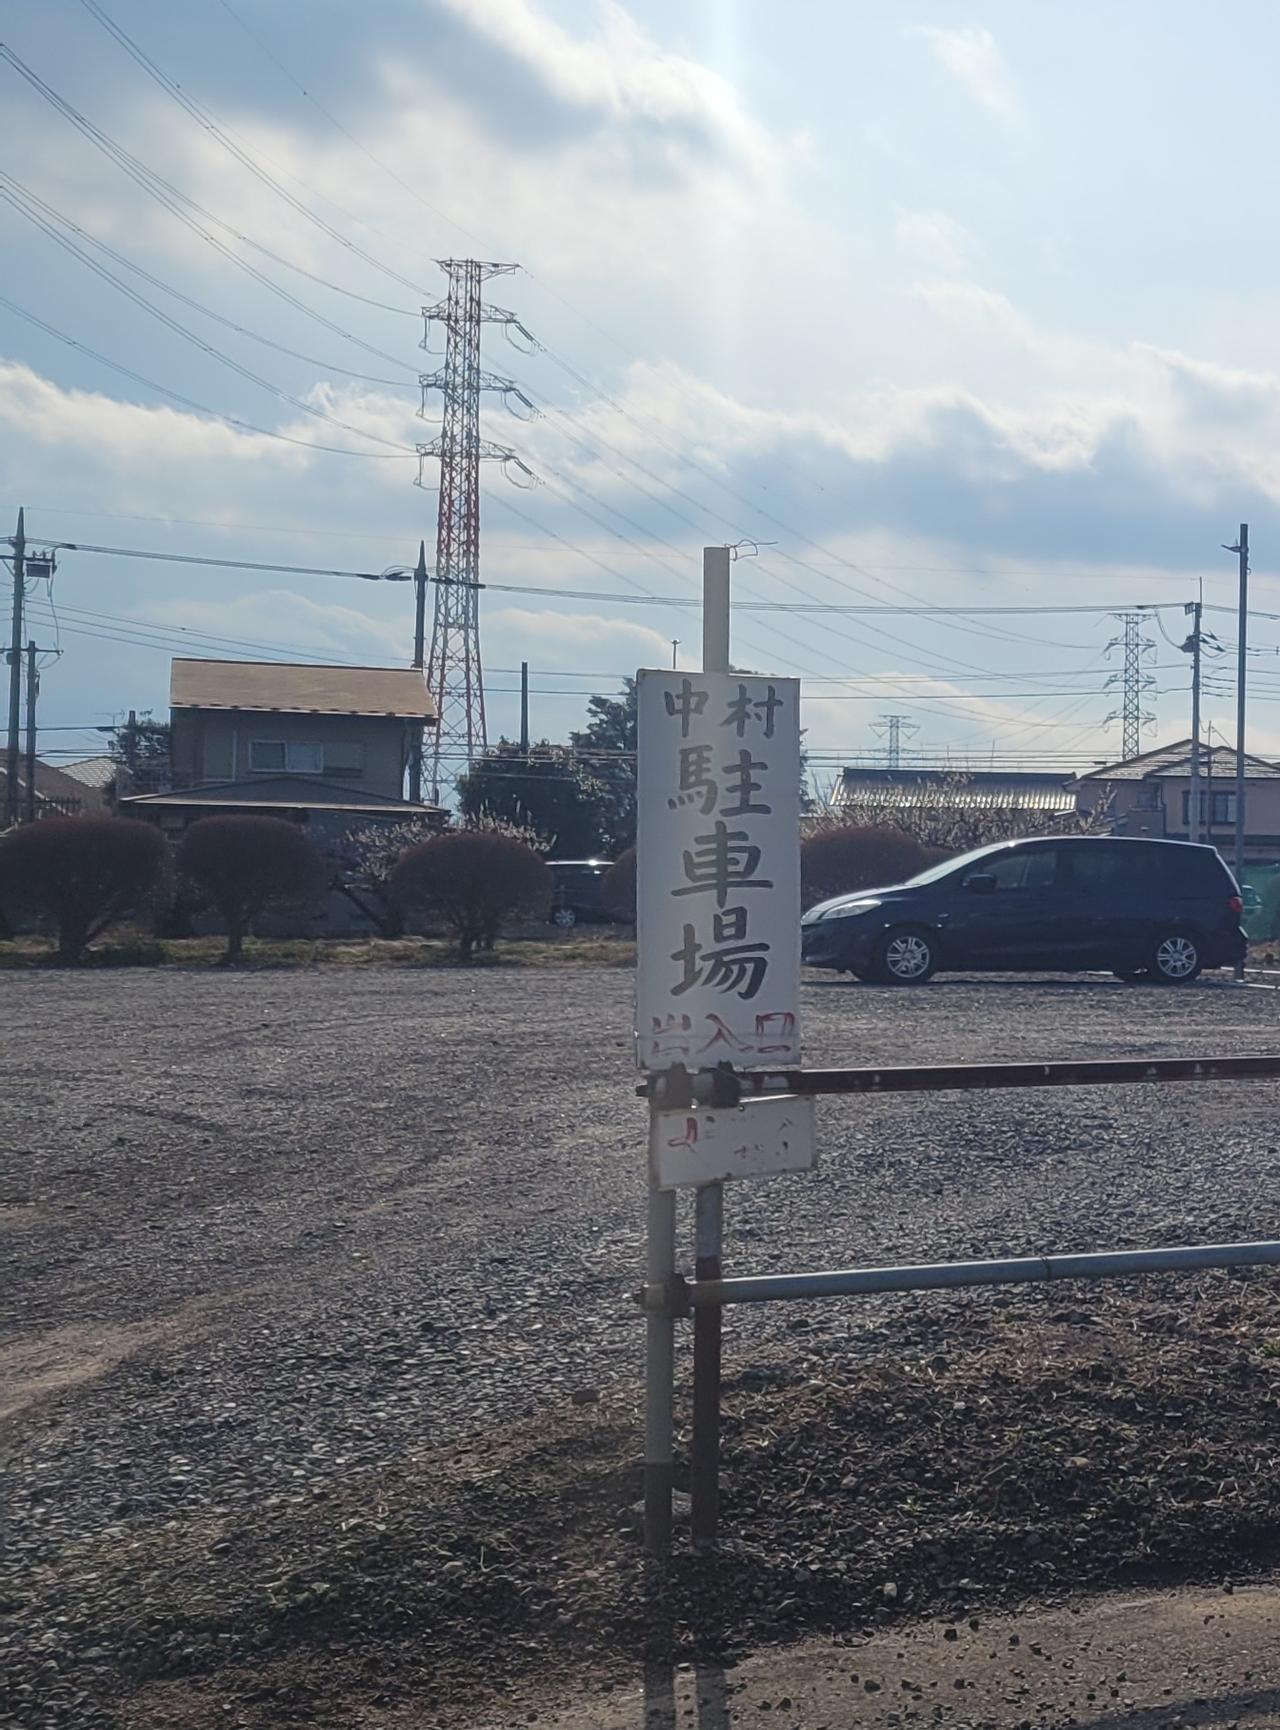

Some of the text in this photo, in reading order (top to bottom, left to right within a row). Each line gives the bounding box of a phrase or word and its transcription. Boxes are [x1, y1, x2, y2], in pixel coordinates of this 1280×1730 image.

[662, 677, 784, 740] 中村
[667, 743, 774, 1001] 駐車場
